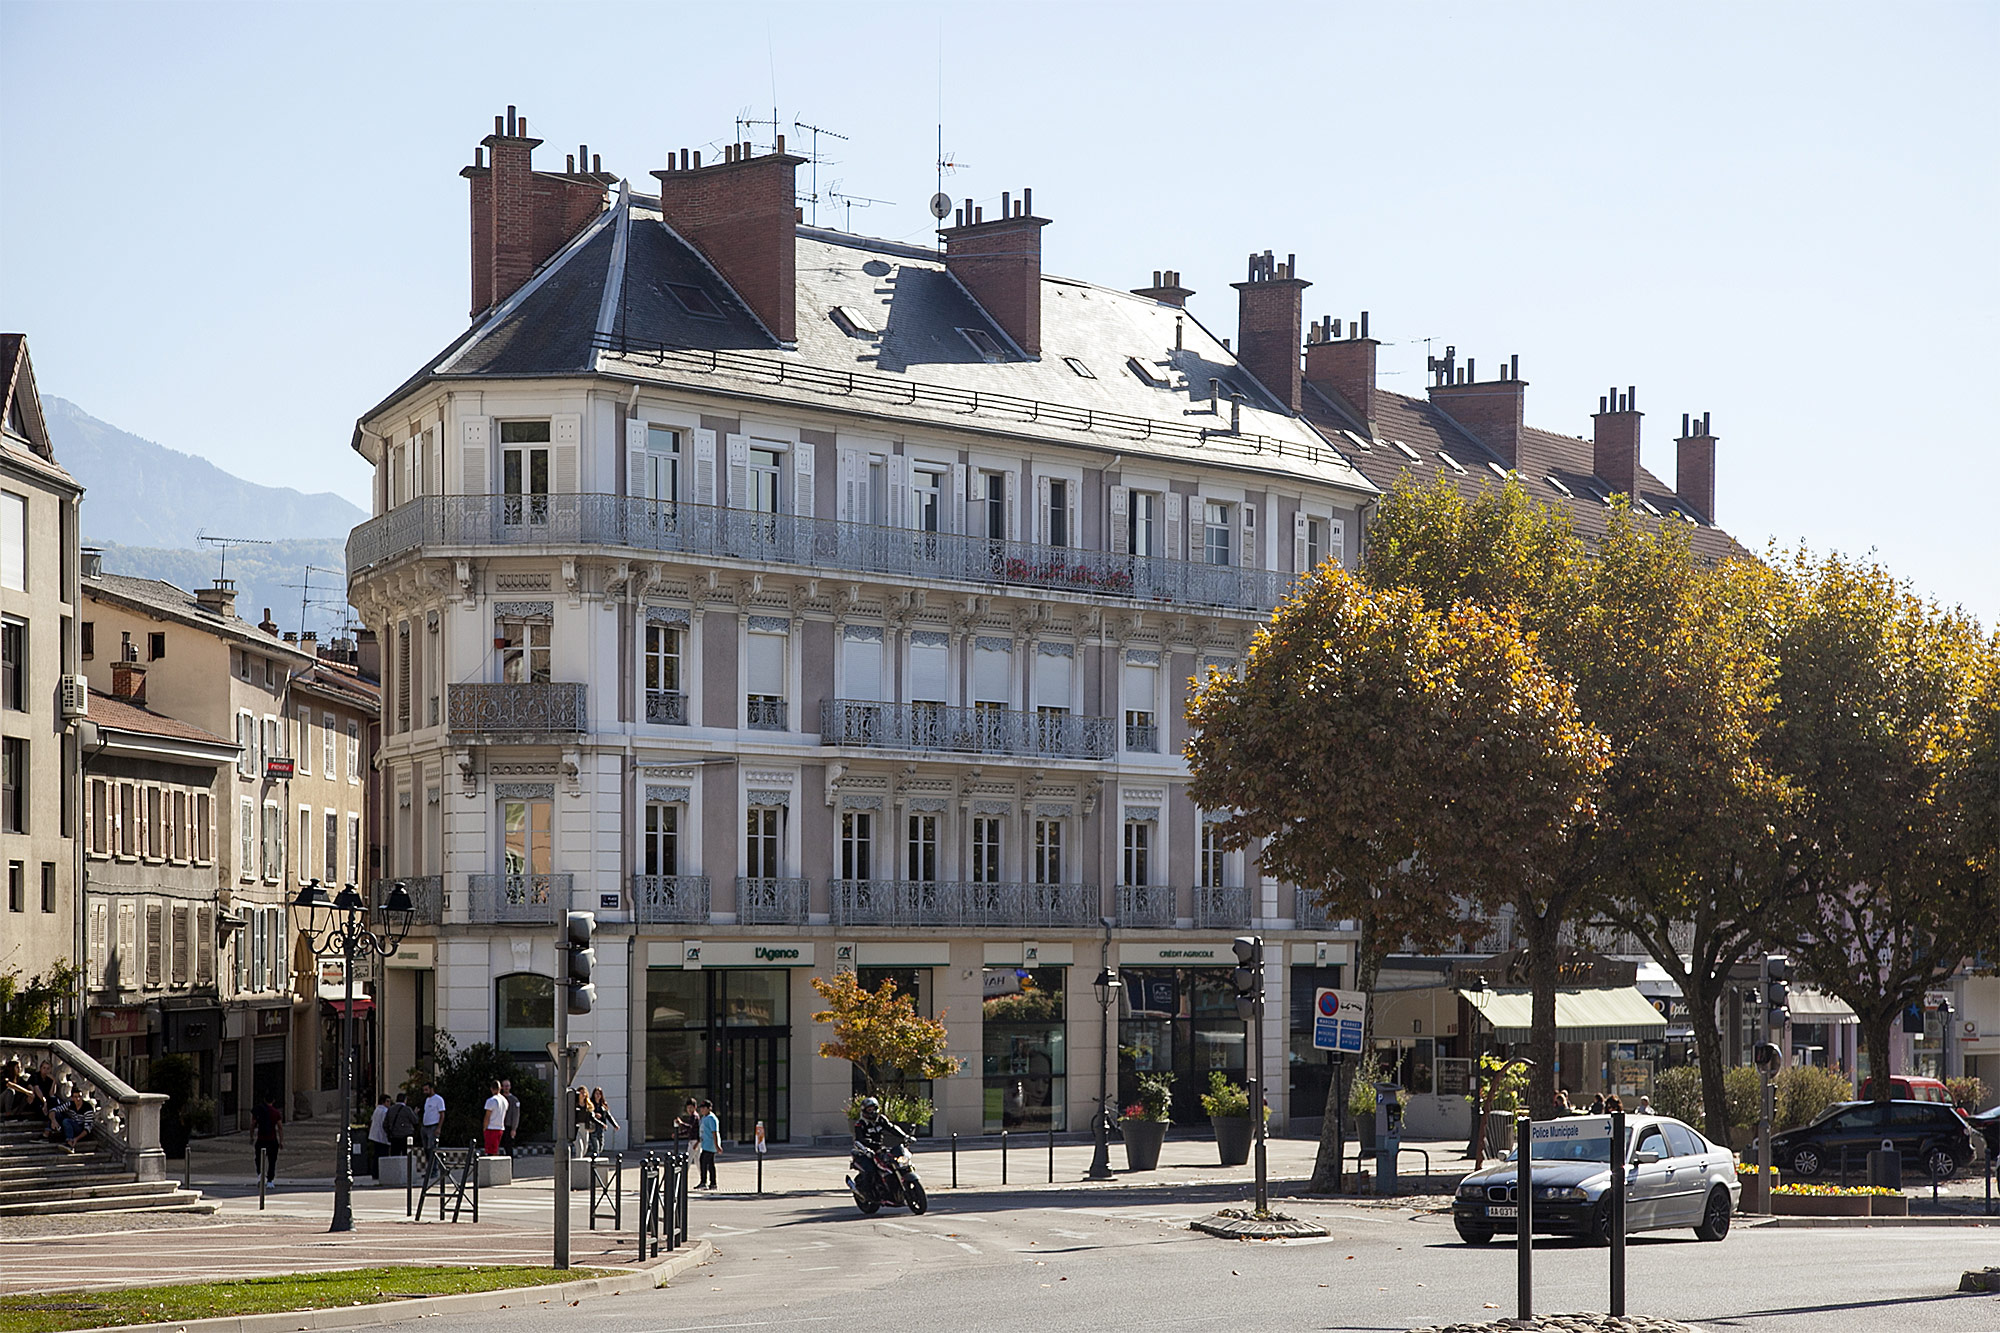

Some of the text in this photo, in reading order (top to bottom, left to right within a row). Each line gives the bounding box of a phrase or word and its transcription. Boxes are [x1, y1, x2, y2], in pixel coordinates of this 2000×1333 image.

[755, 947, 799, 961] L'Agence
[1159, 949, 1214, 958] CRÉDIT AGRICOLE
[1378, 1093, 1384, 1103] P
[1532, 1125, 1579, 1139] Police Municipale
